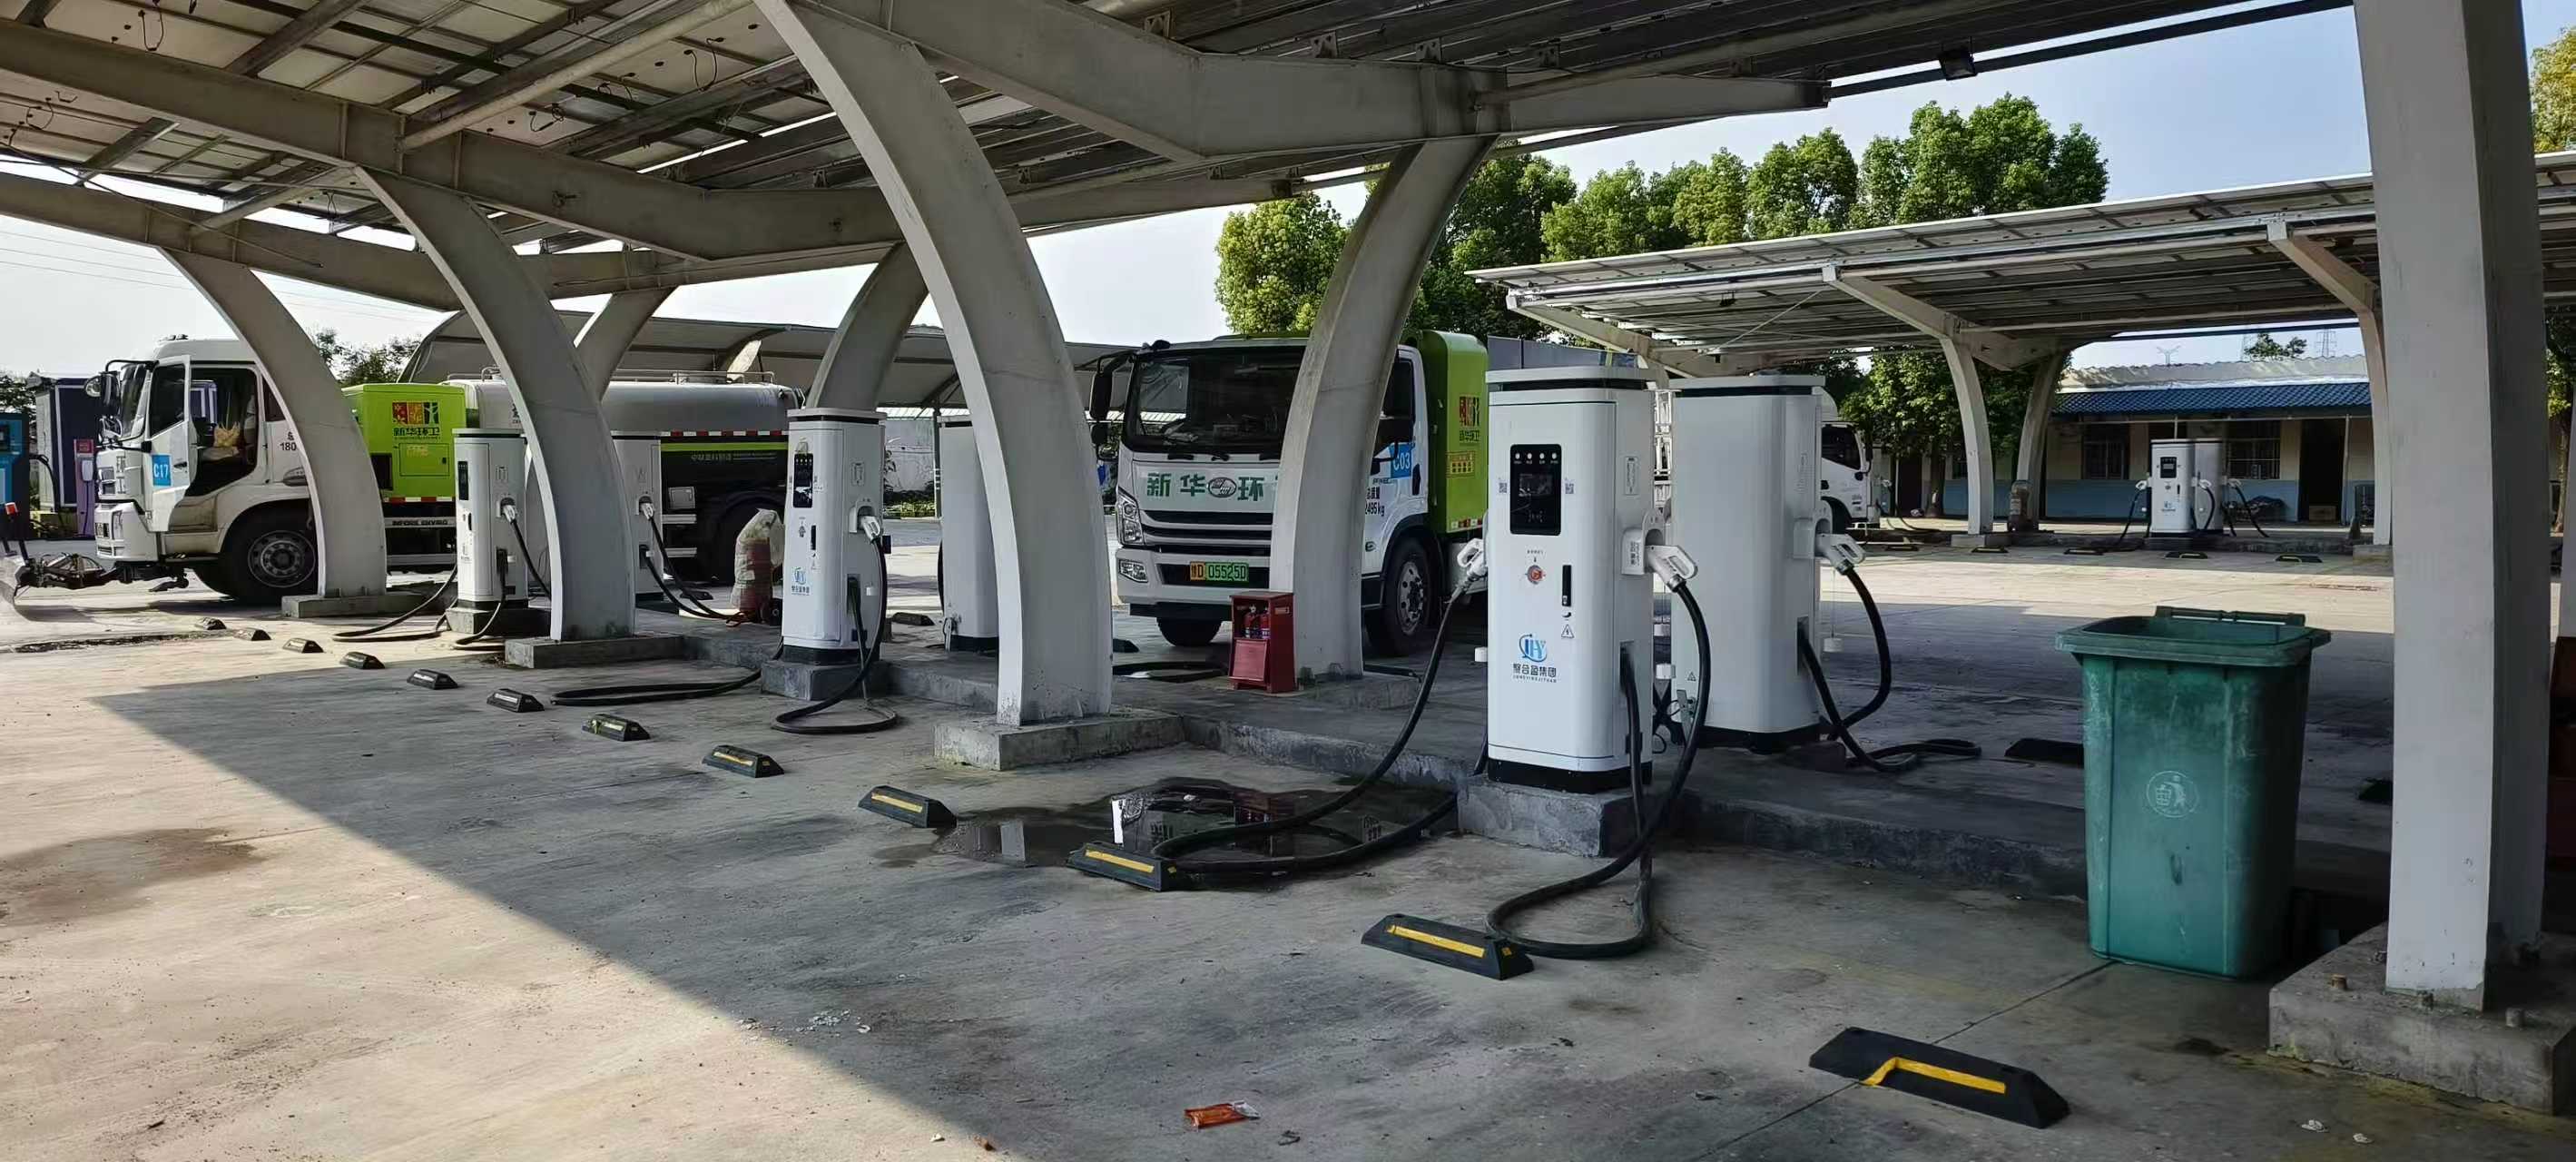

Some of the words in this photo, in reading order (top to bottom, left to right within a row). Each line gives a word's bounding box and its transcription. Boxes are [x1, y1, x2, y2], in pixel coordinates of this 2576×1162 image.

[1393, 452, 1411, 470] C03
[153, 463, 169, 478] C17
[1146, 472, 1278, 502] 新华环
